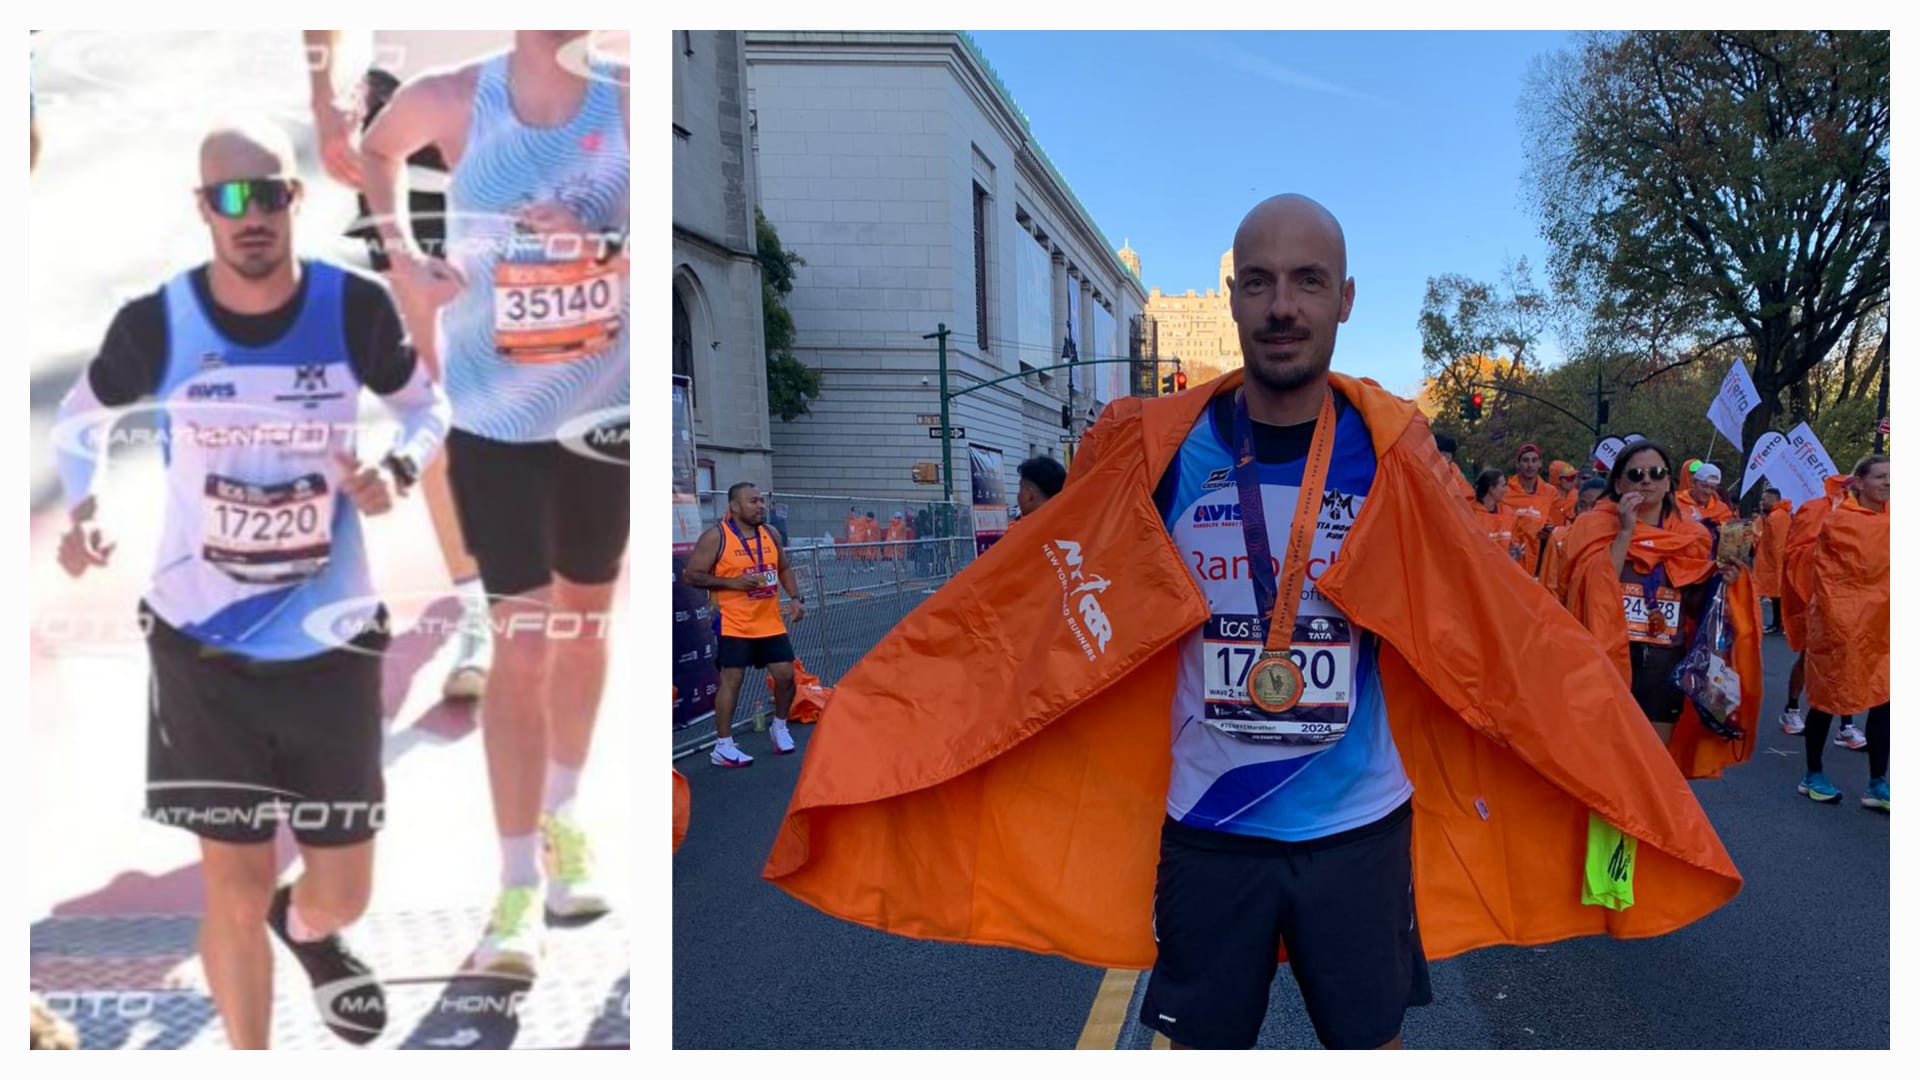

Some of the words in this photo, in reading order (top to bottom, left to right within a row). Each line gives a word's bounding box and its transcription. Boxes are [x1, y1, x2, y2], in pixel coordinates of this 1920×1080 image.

[506, 280, 611, 322] 35140
[1750, 435, 1782, 471] effetto
[214, 504, 319, 541] 17220
[1193, 503, 1242, 522] AVIS
[1042, 544, 1060, 567] NEW
[1066, 617, 1097, 662] RUNNERS
[1622, 598, 1675, 621] 2478
[1220, 617, 1250, 638] tcs
[1308, 632, 1332, 640] TATA
[1217, 647, 1335, 690] 1720
[1301, 724, 1332, 733] 2024
